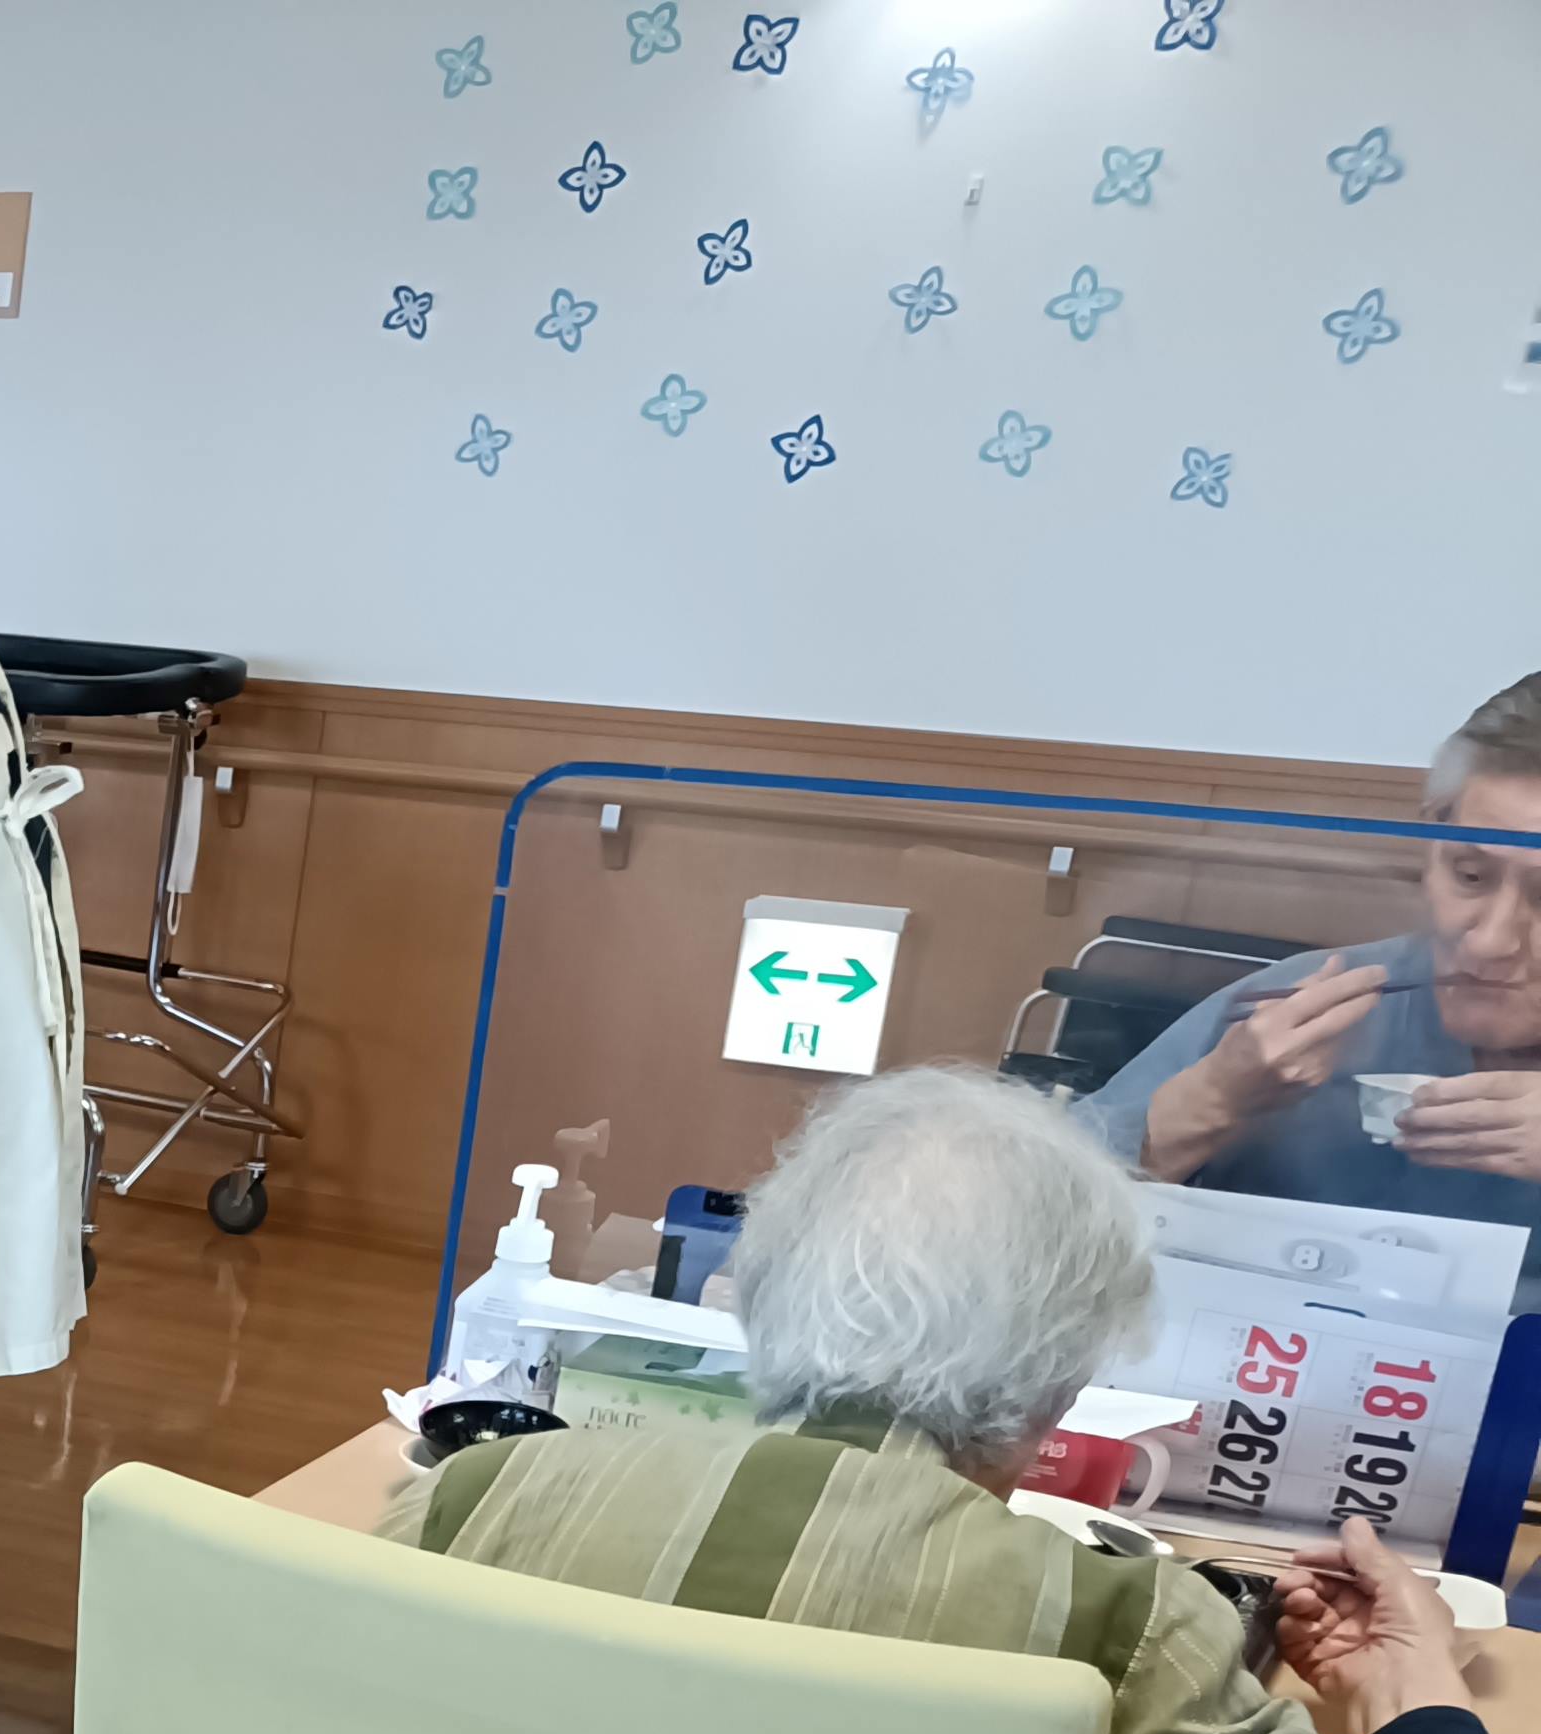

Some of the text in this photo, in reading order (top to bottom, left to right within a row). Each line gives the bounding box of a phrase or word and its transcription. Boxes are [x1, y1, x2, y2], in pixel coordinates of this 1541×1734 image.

[1207, 1324, 1308, 1508] 25 26 27
[1362, 1359, 1437, 1421] 18
[1343, 1430, 1416, 1486] 19
